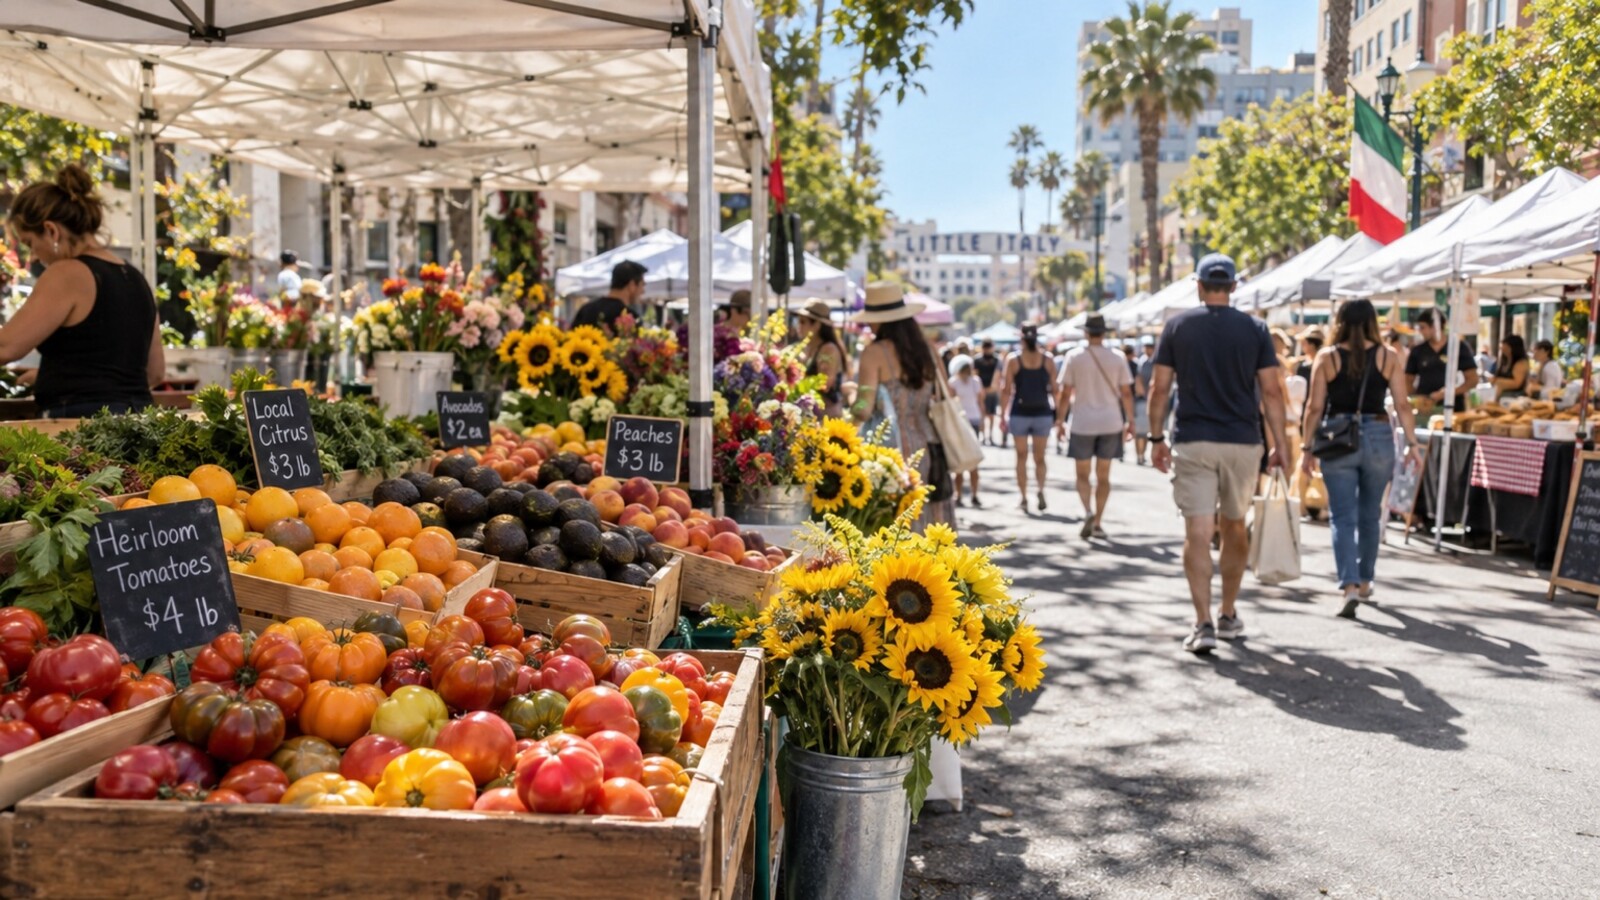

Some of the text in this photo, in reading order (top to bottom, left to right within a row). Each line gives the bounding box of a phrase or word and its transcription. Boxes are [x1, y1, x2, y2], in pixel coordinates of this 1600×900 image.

[906, 234, 1060, 251] LITTLE ITALY
[252, 395, 294, 419] Local
[441, 395, 484, 414] Avocados
[258, 423, 308, 446] Citrus
[447, 417, 483, 440] $2 ea
[614, 420, 673, 444] Peaches
[268, 451, 311, 479] $3 lb
[617, 445, 664, 472] $3 lb
[94, 520, 199, 558] Heirloom
[106, 555, 212, 593] Tomatoes
[142, 595, 219, 635] $4 lb
